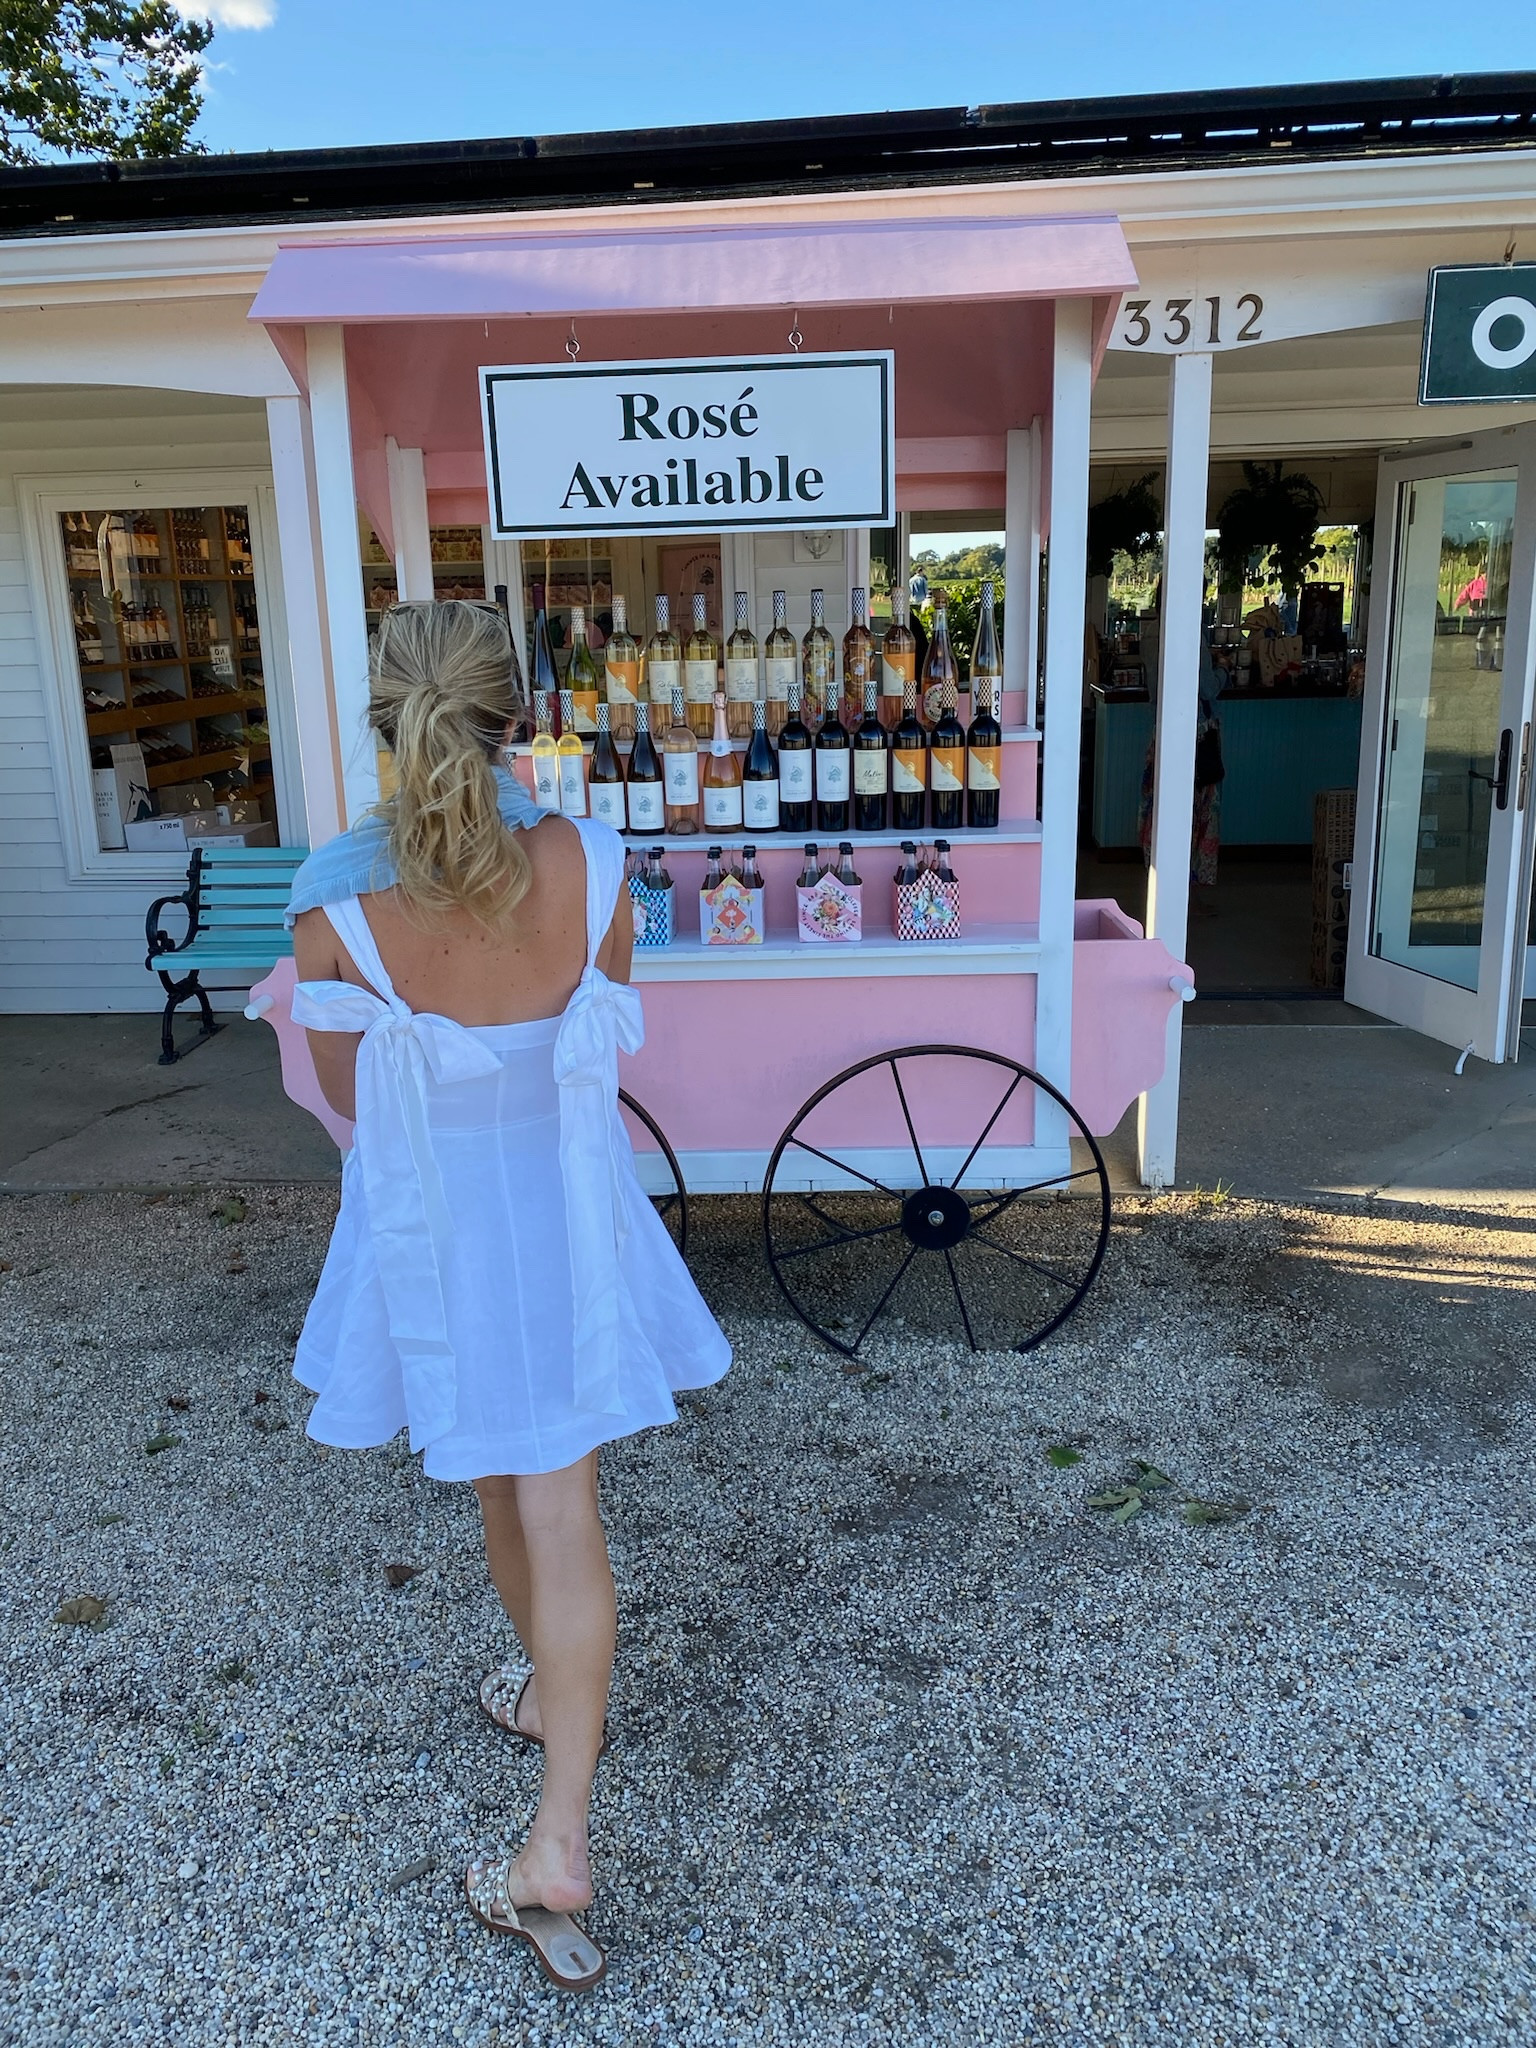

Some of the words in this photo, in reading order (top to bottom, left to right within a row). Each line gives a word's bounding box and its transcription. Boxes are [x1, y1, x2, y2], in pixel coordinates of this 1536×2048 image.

[1124, 293, 1264, 347] 3312
[1471, 295, 1536, 370] O
[616, 386, 759, 441] Rosé
[559, 455, 825, 509] Available
